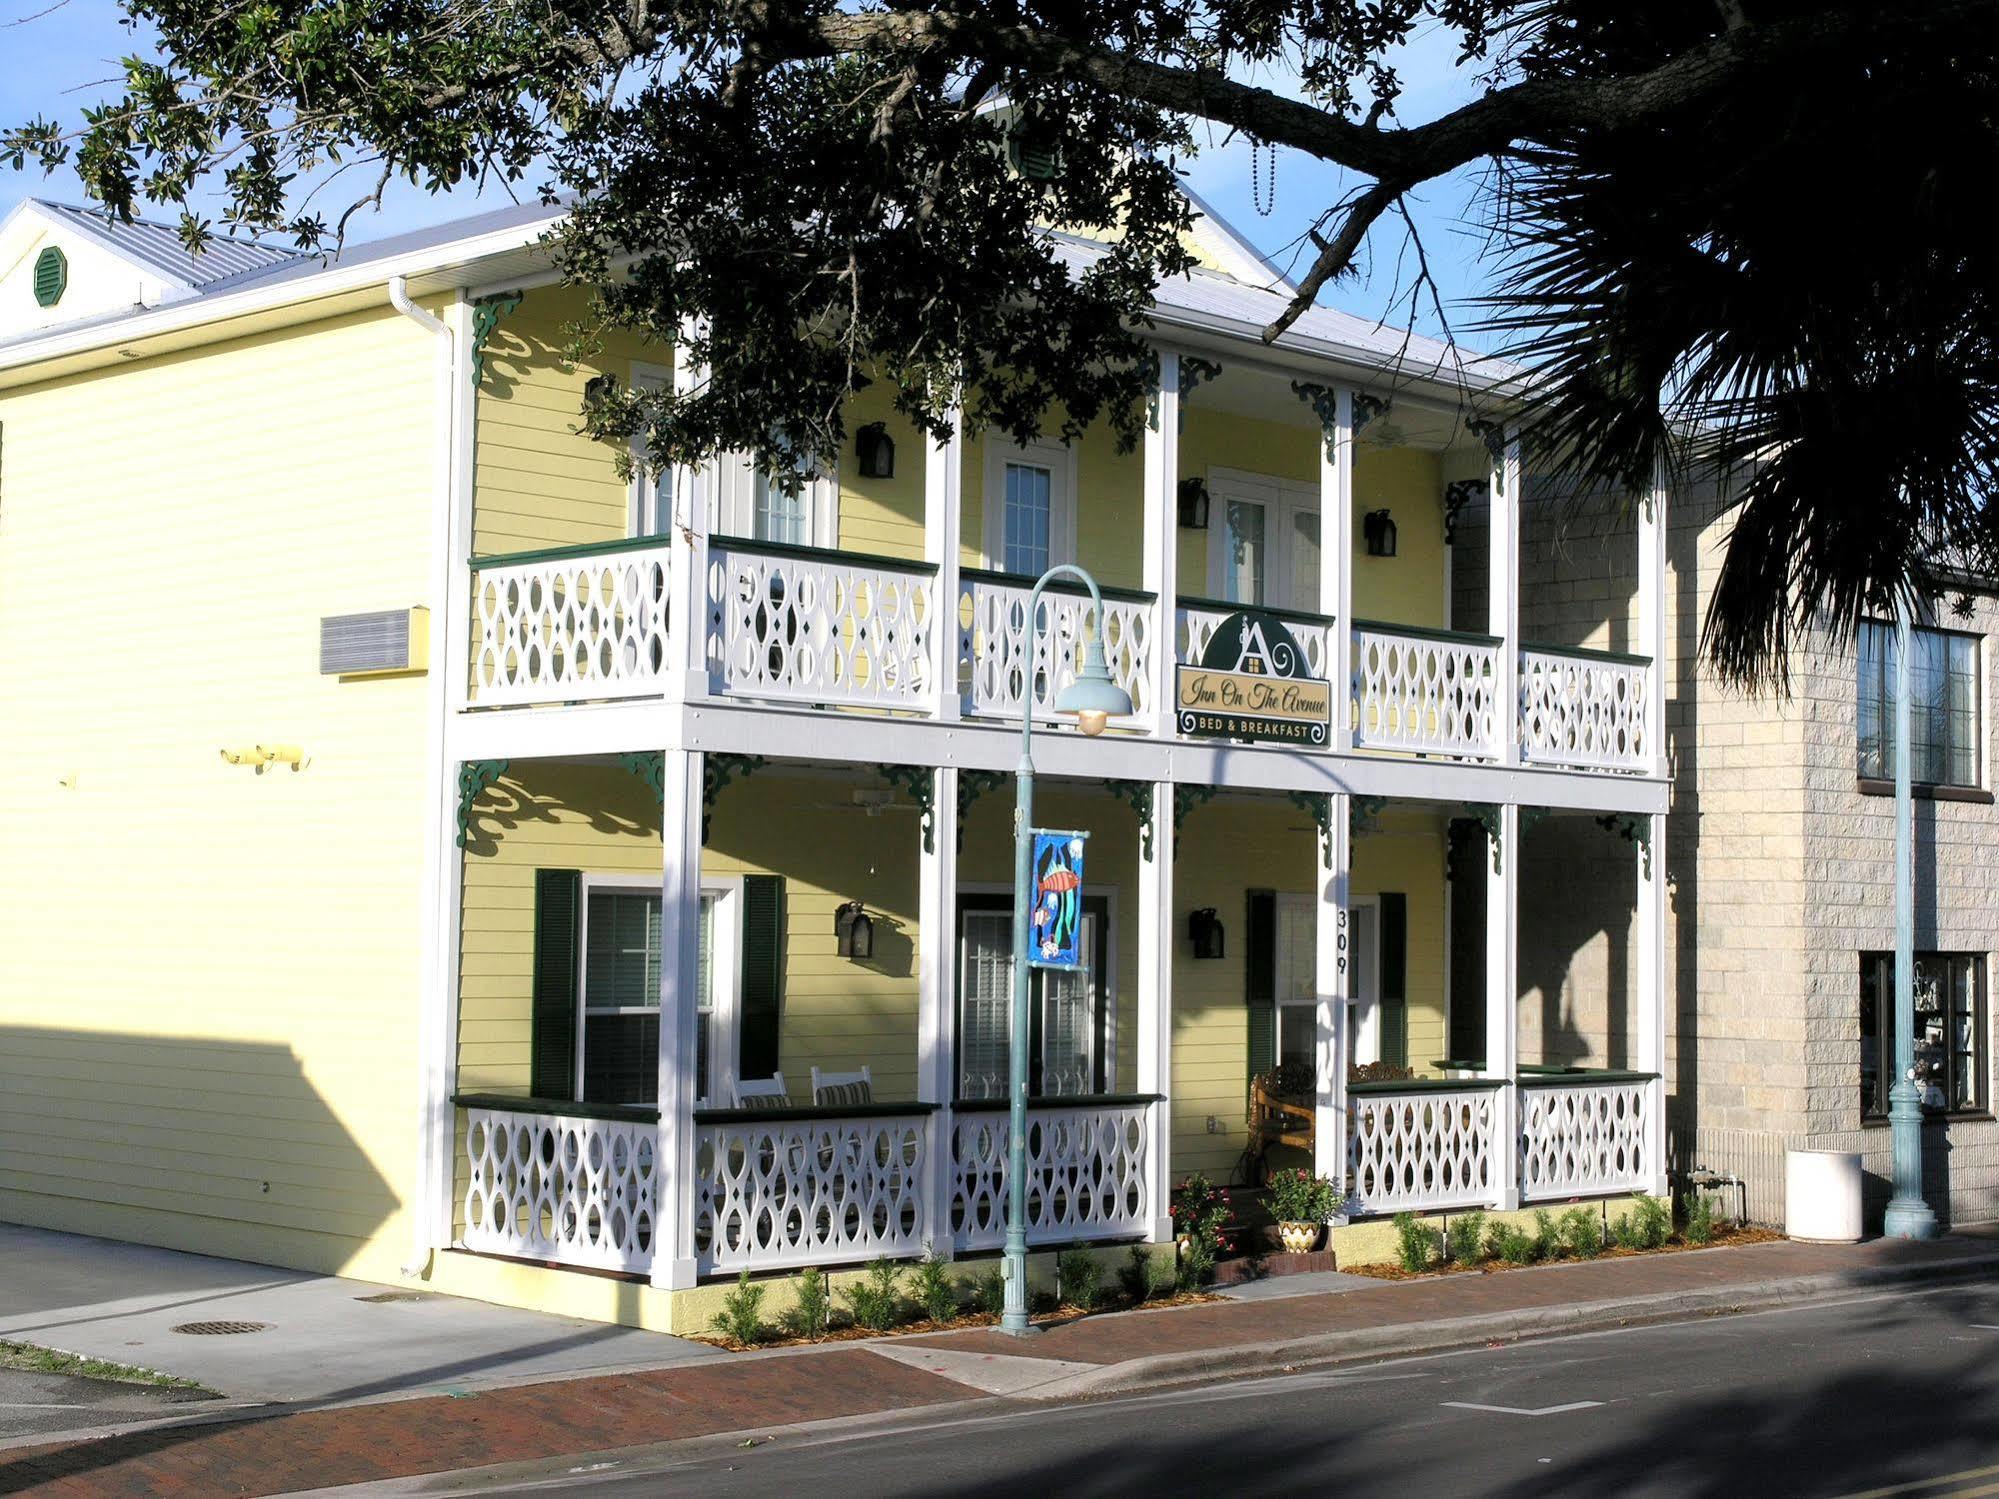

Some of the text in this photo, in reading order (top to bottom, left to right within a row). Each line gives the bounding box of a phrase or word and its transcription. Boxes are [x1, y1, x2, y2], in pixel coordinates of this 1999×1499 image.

[1181, 675, 1325, 714] Inn On The Avenue
[1199, 717, 1308, 737] BED & BREAKFAST
[1337, 911, 1347, 974] 309
